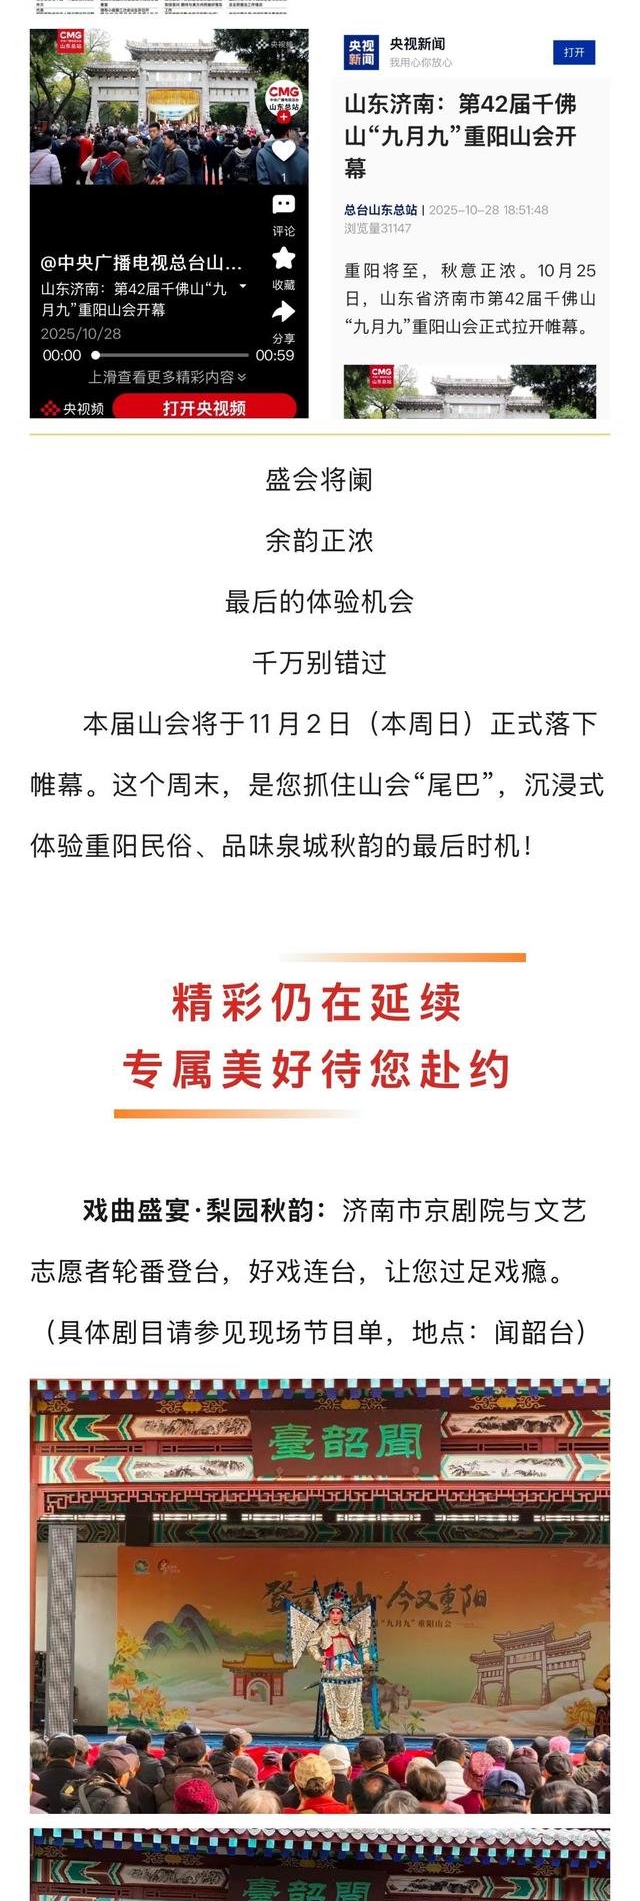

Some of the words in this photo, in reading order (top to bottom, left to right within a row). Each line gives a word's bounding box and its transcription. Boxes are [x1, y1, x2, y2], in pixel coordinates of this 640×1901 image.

[60, 31, 82, 39] CMG
[348, 40, 374, 52] 央视
[389, 37, 446, 50] 央视新闻
[349, 53, 374, 65] 新闻
[564, 47, 585, 57] 打开
[390, 57, 453, 68] 我用心你放心
[269, 87, 299, 97] CMG
[345, 93, 577, 115] 山东济南：第42届千佛
[345, 125, 577, 147] 山“九月九”重阳山会开
[345, 158, 366, 179] 幕
[344, 204, 418, 216] 总台山东总站
[503, 205, 549, 215] 18:51:48
[272, 226, 296, 237] 评论
[344, 223, 412, 235] 浏览量31147
[41, 282, 227, 296] 山东济南：第42届千佛山“九
[272, 279, 296, 291] 收藏
[346, 291, 596, 307] 日，山东省济南市第42届千佛山
[42, 303, 166, 317] 月九”重阳山会开幕
[345, 318, 586, 335] “九月九”重阳山会正式拉开帷幕。
[41, 327, 121, 341] 2025/10/28
[272, 333, 296, 344] 分享
[42, 349, 82, 362] 00:00
[255, 349, 295, 362] 00:59
[88, 370, 234, 385] 上滑查看更多精彩内容
[64, 403, 104, 416] 央视频
[163, 401, 246, 417] 打开央视频
[266, 467, 371, 492] 盛会将阑
[266, 528, 373, 552] 余韵正浓
[225, 589, 413, 614] 最后的体验机会
[253, 650, 386, 675] 千万别错过
[31, 833, 533, 858] 体验重阳民俗、品味泉城秋韵的最后时机！
[172, 982, 460, 1022] 精彩仍在延续
[123, 1049, 508, 1089] 专属美好待您赴约
[31, 1259, 565, 1285] 志愿者轮番登台，好戏连台，让您过足戏瘾。
